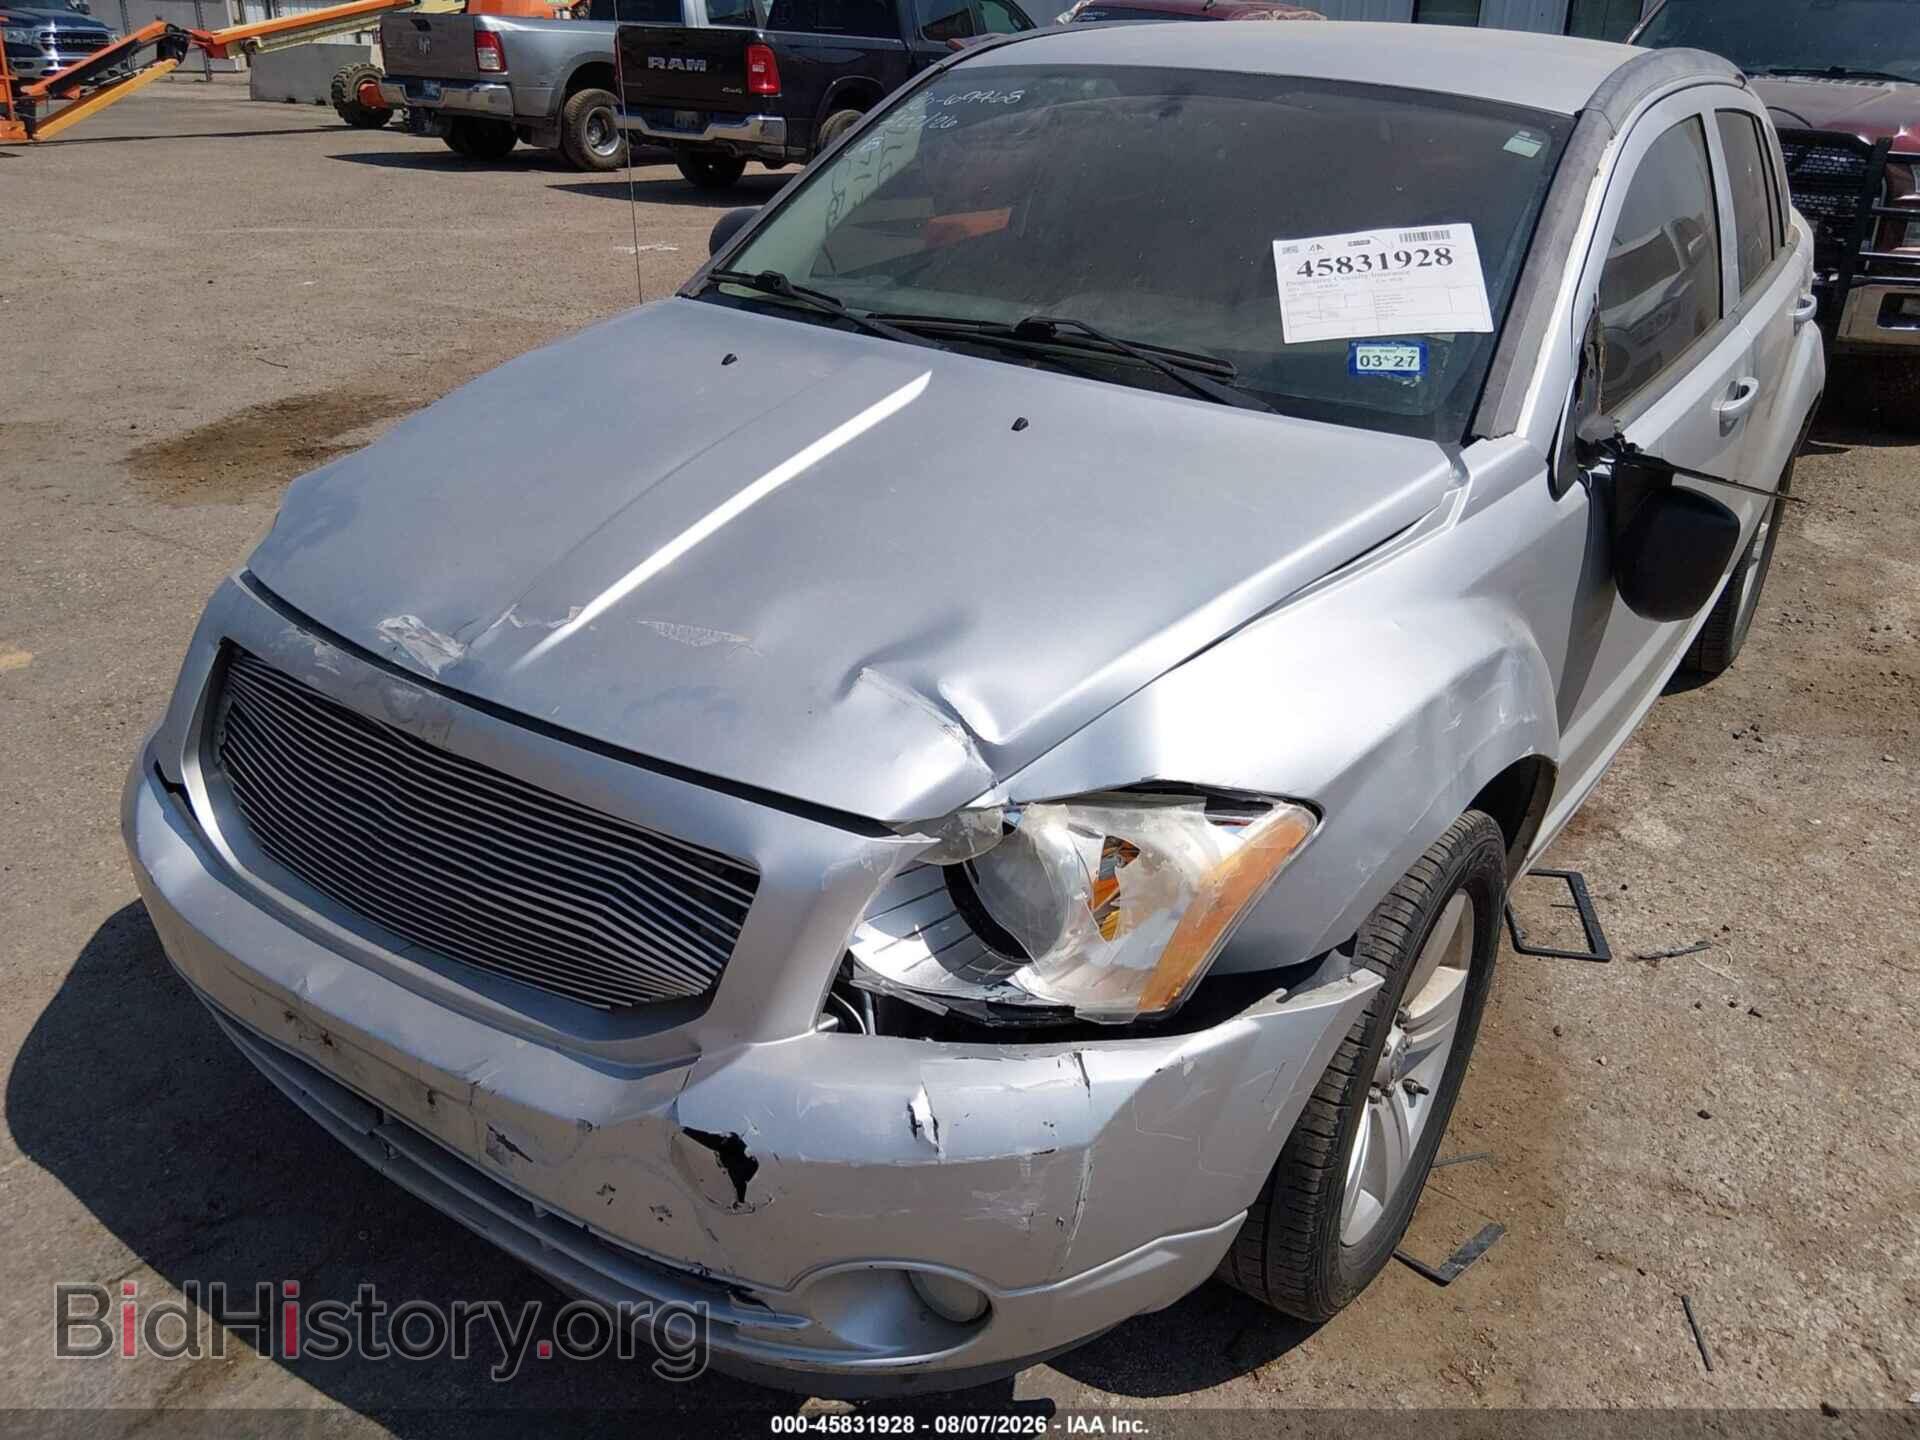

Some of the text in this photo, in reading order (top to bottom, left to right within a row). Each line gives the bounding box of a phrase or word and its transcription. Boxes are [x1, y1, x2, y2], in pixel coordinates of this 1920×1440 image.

[647, 56, 707, 72] RAM
[1296, 246, 1454, 278] 45831928
[1359, 354, 1417, 368] 03 27
